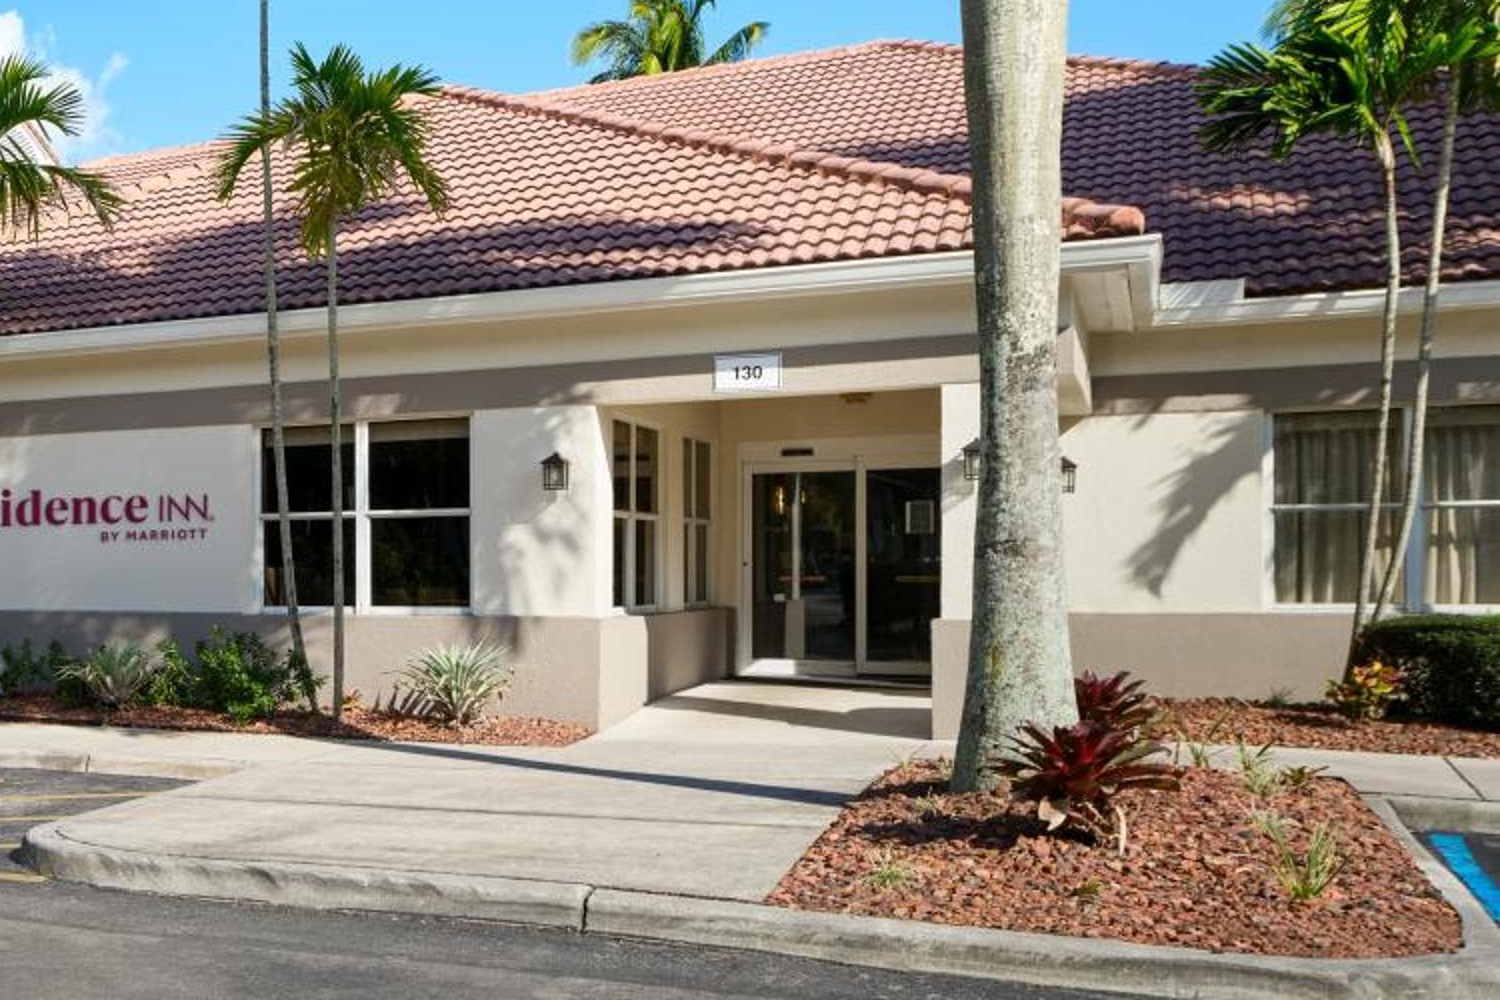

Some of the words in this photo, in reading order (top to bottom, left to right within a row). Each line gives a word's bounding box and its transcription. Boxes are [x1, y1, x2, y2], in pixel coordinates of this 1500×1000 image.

[734, 365, 763, 380] 130
[100, 531, 119, 543] BY
[127, 528, 208, 541] MARRIOTT
